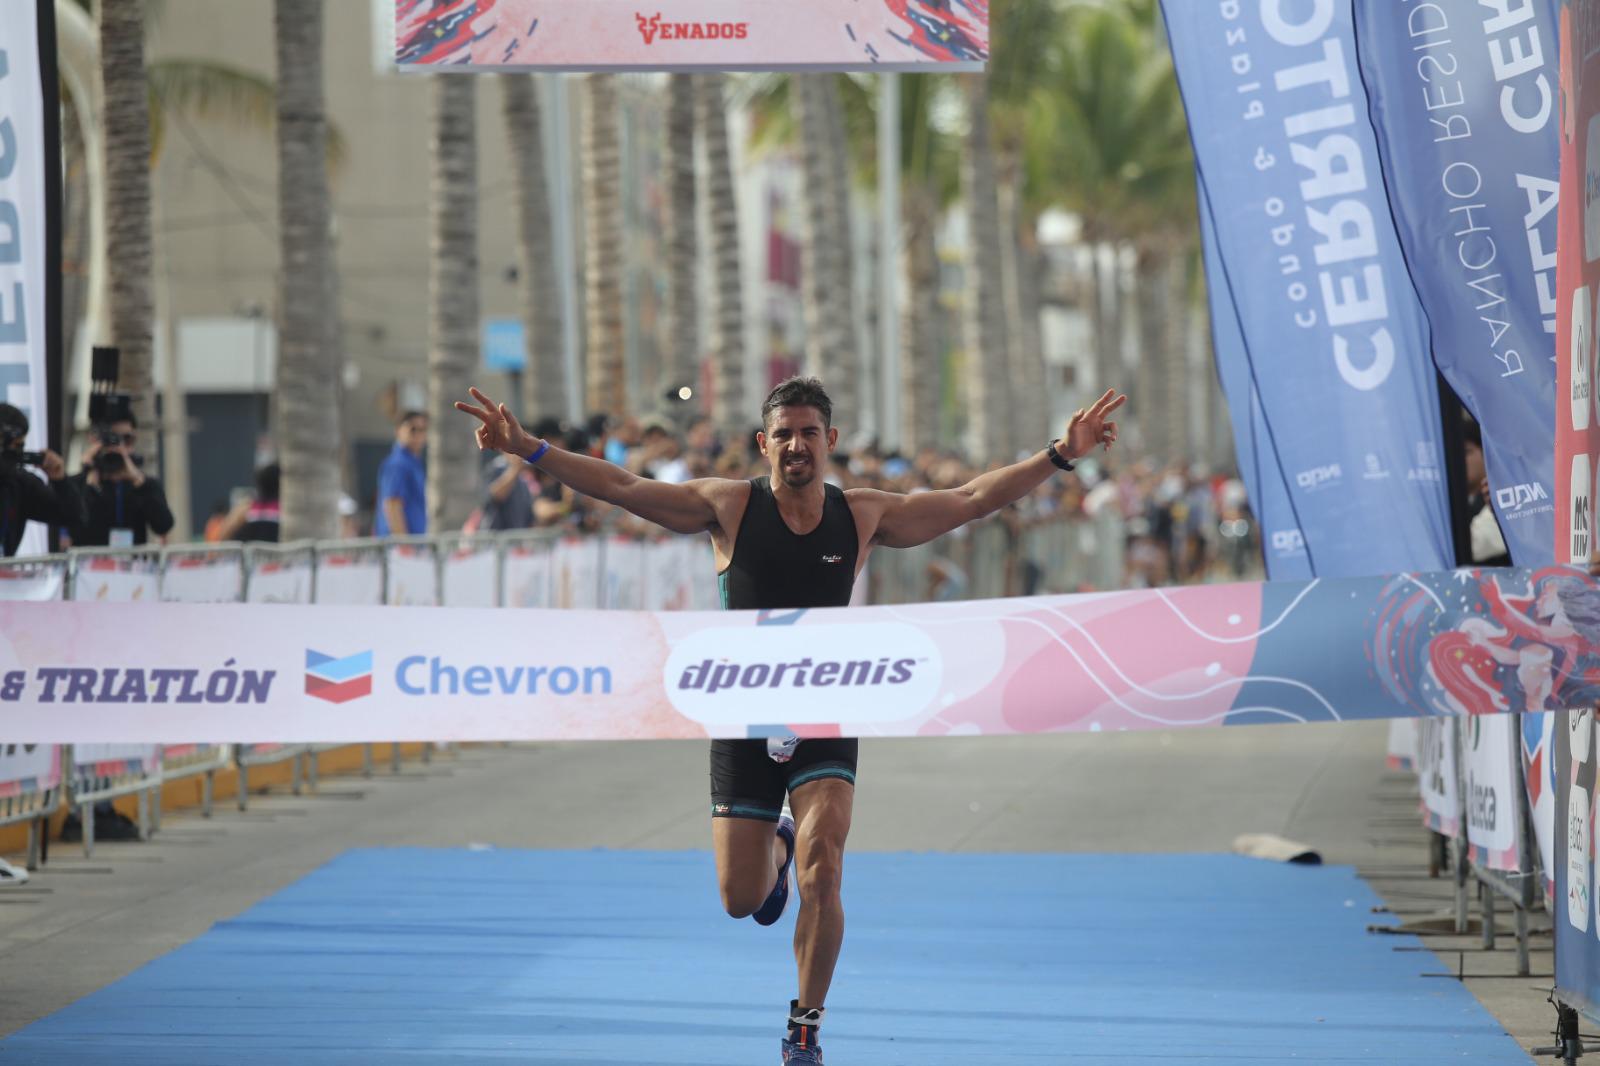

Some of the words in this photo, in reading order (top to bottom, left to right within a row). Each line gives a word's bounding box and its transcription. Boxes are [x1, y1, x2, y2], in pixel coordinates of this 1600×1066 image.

[634, 12, 748, 45] VENADOS
[0, 670, 26, 701] &
[36, 657, 277, 704] TRIATLÓN
[394, 655, 613, 696] Chevron
[678, 656, 917, 694] dportenis
